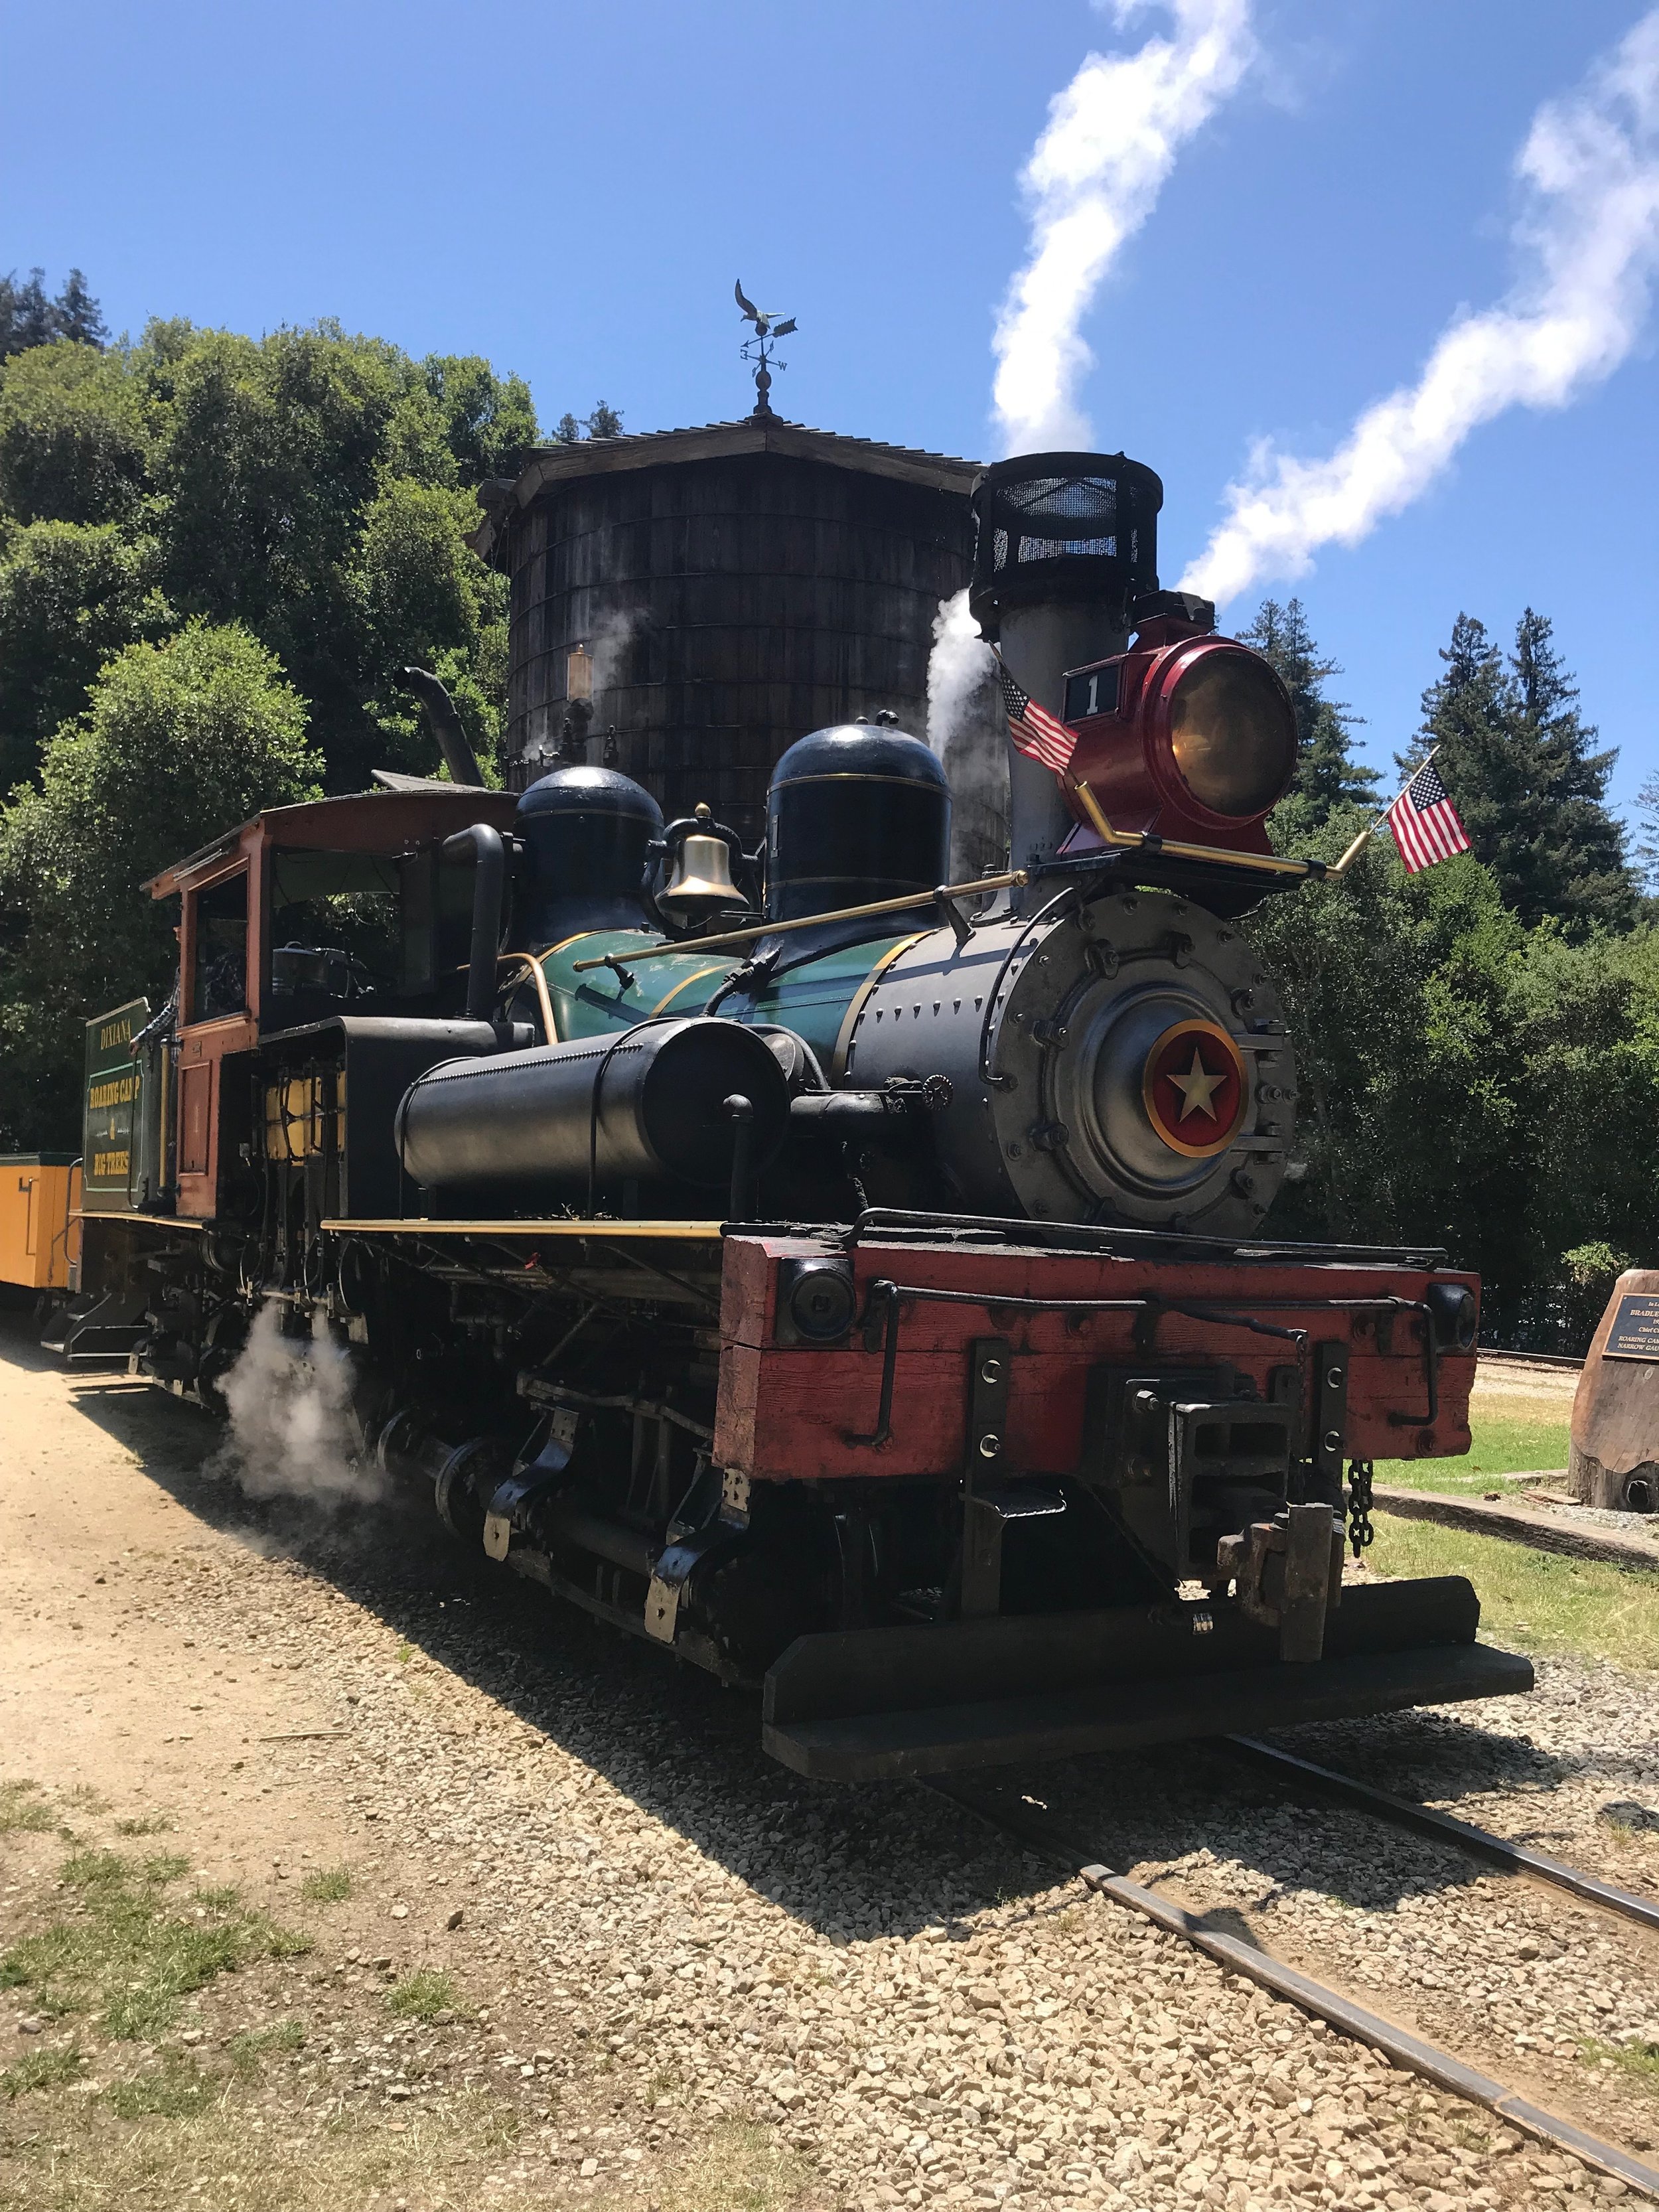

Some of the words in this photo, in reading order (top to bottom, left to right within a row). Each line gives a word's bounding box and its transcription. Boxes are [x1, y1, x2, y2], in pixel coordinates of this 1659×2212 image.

[778, 360, 788, 371] W
[1086, 675, 1099, 715] 1
[101, 1018, 131, 1050] DIXIANA
[90, 1082, 119, 1110] ROARING
[109, 1118, 115, 1140] &
[94, 1153, 106, 1175] BIG
[107, 1150, 129, 1175] TREES
